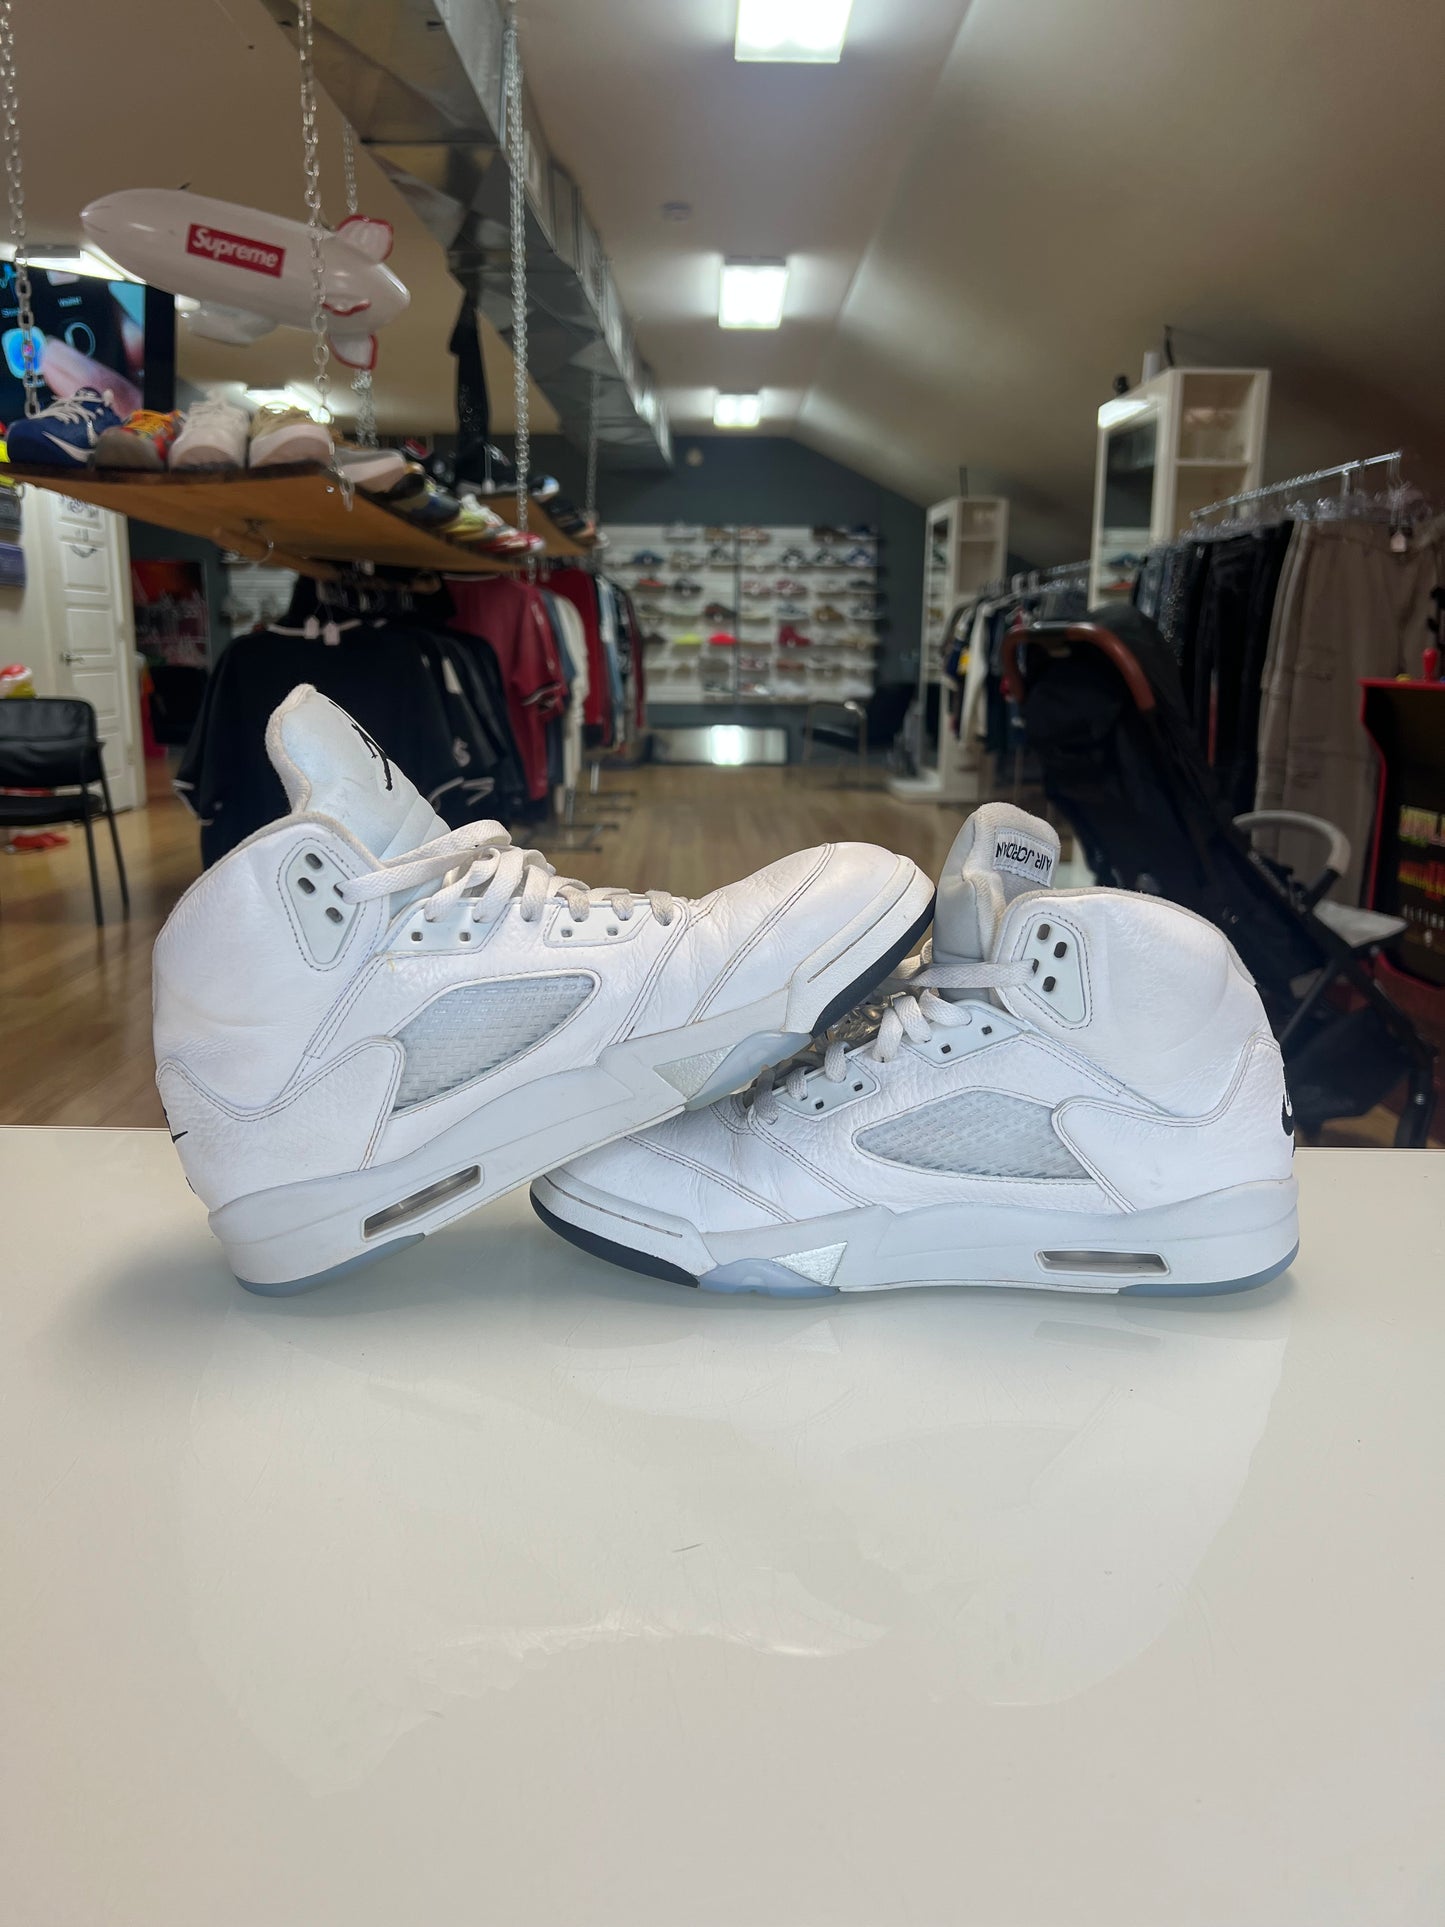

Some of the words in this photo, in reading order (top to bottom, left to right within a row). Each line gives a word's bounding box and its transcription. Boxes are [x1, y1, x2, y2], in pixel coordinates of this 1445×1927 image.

[191, 228, 280, 268] Supreme
[995, 842, 1035, 864] JORDAN
[1034, 852, 1053, 872] AIR
